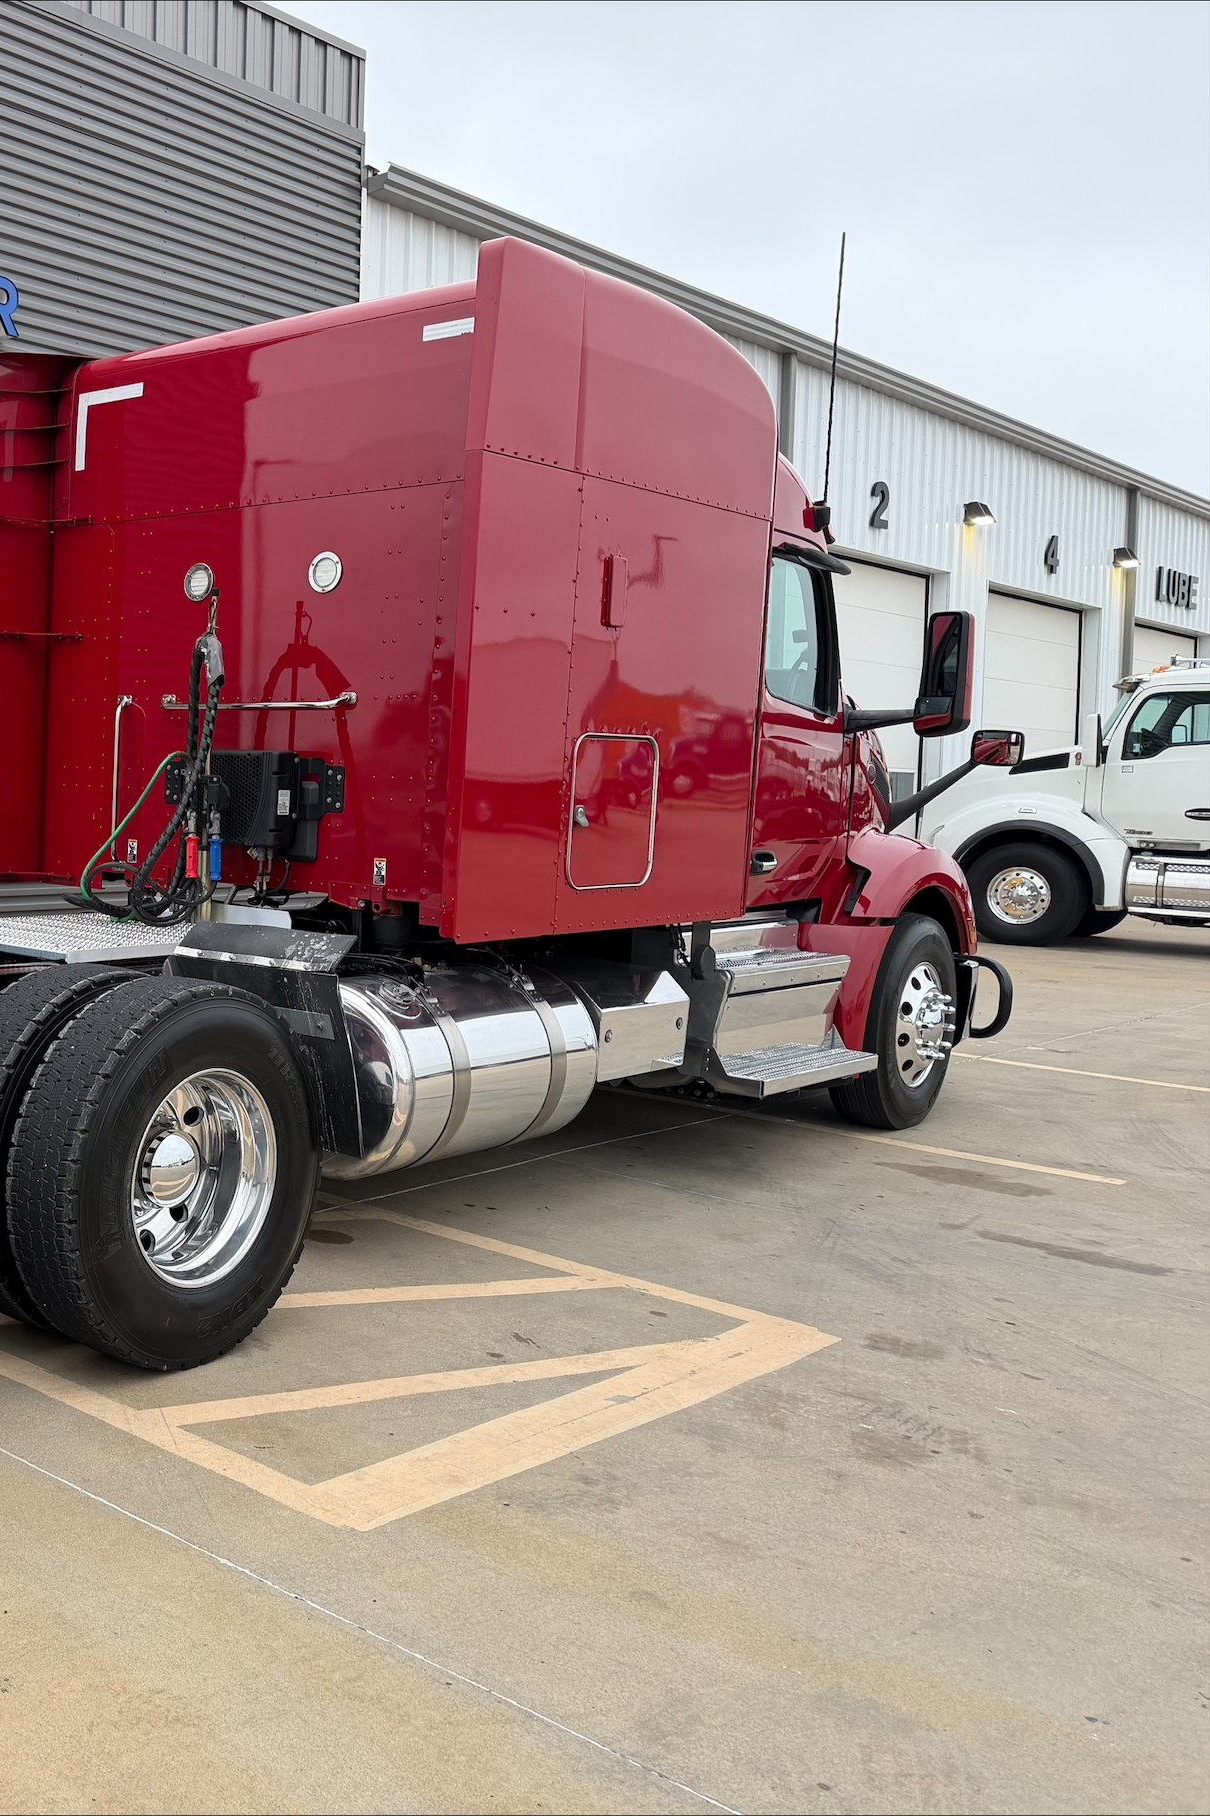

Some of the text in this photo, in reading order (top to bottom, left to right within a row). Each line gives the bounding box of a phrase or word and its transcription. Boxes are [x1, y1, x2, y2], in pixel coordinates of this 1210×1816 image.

[870, 481, 890, 529] 2
[1044, 535, 1060, 574] 4
[1155, 565, 1199, 610] LUBE
